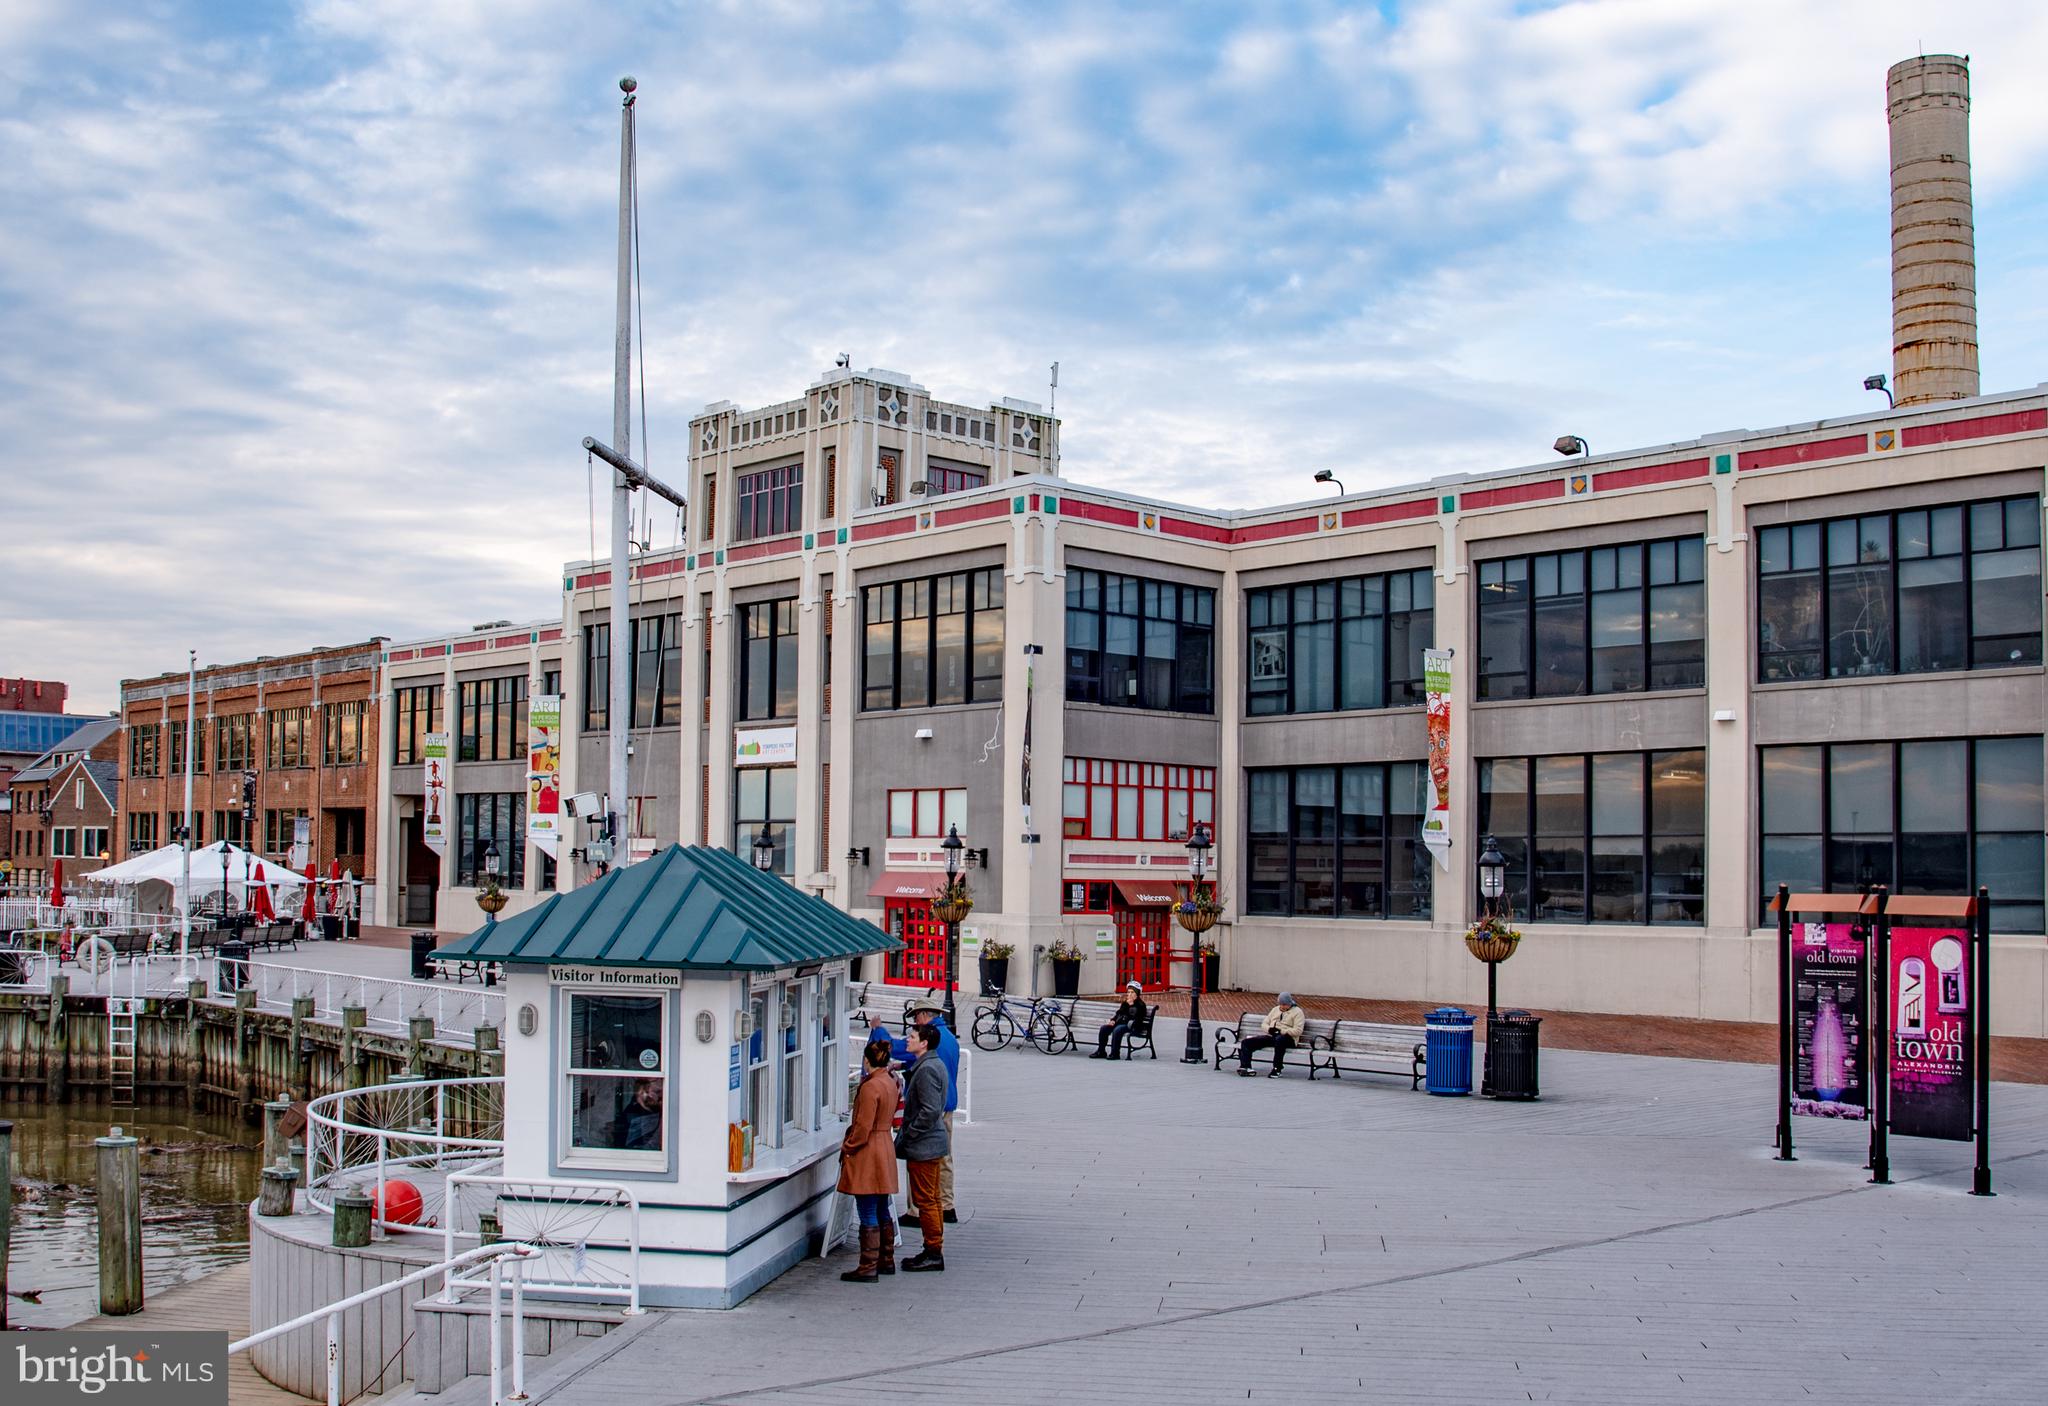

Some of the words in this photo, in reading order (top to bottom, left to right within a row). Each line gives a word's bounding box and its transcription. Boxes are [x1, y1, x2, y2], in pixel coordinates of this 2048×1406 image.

[1427, 657, 1450, 673] ART
[533, 700, 559, 712] ART
[427, 737, 446, 746] ART
[895, 885, 925, 894] Welcome
[1136, 894, 1172, 902] Welcome
[1806, 950, 1825, 963] old
[1828, 952, 1857, 964] town
[551, 968, 595, 982] Visitor
[600, 971, 679, 985] Information
[1930, 1020, 1963, 1043] old
[1895, 1035, 1964, 1062] town
[1897, 1061, 1962, 1071] ALEXANDRIA
